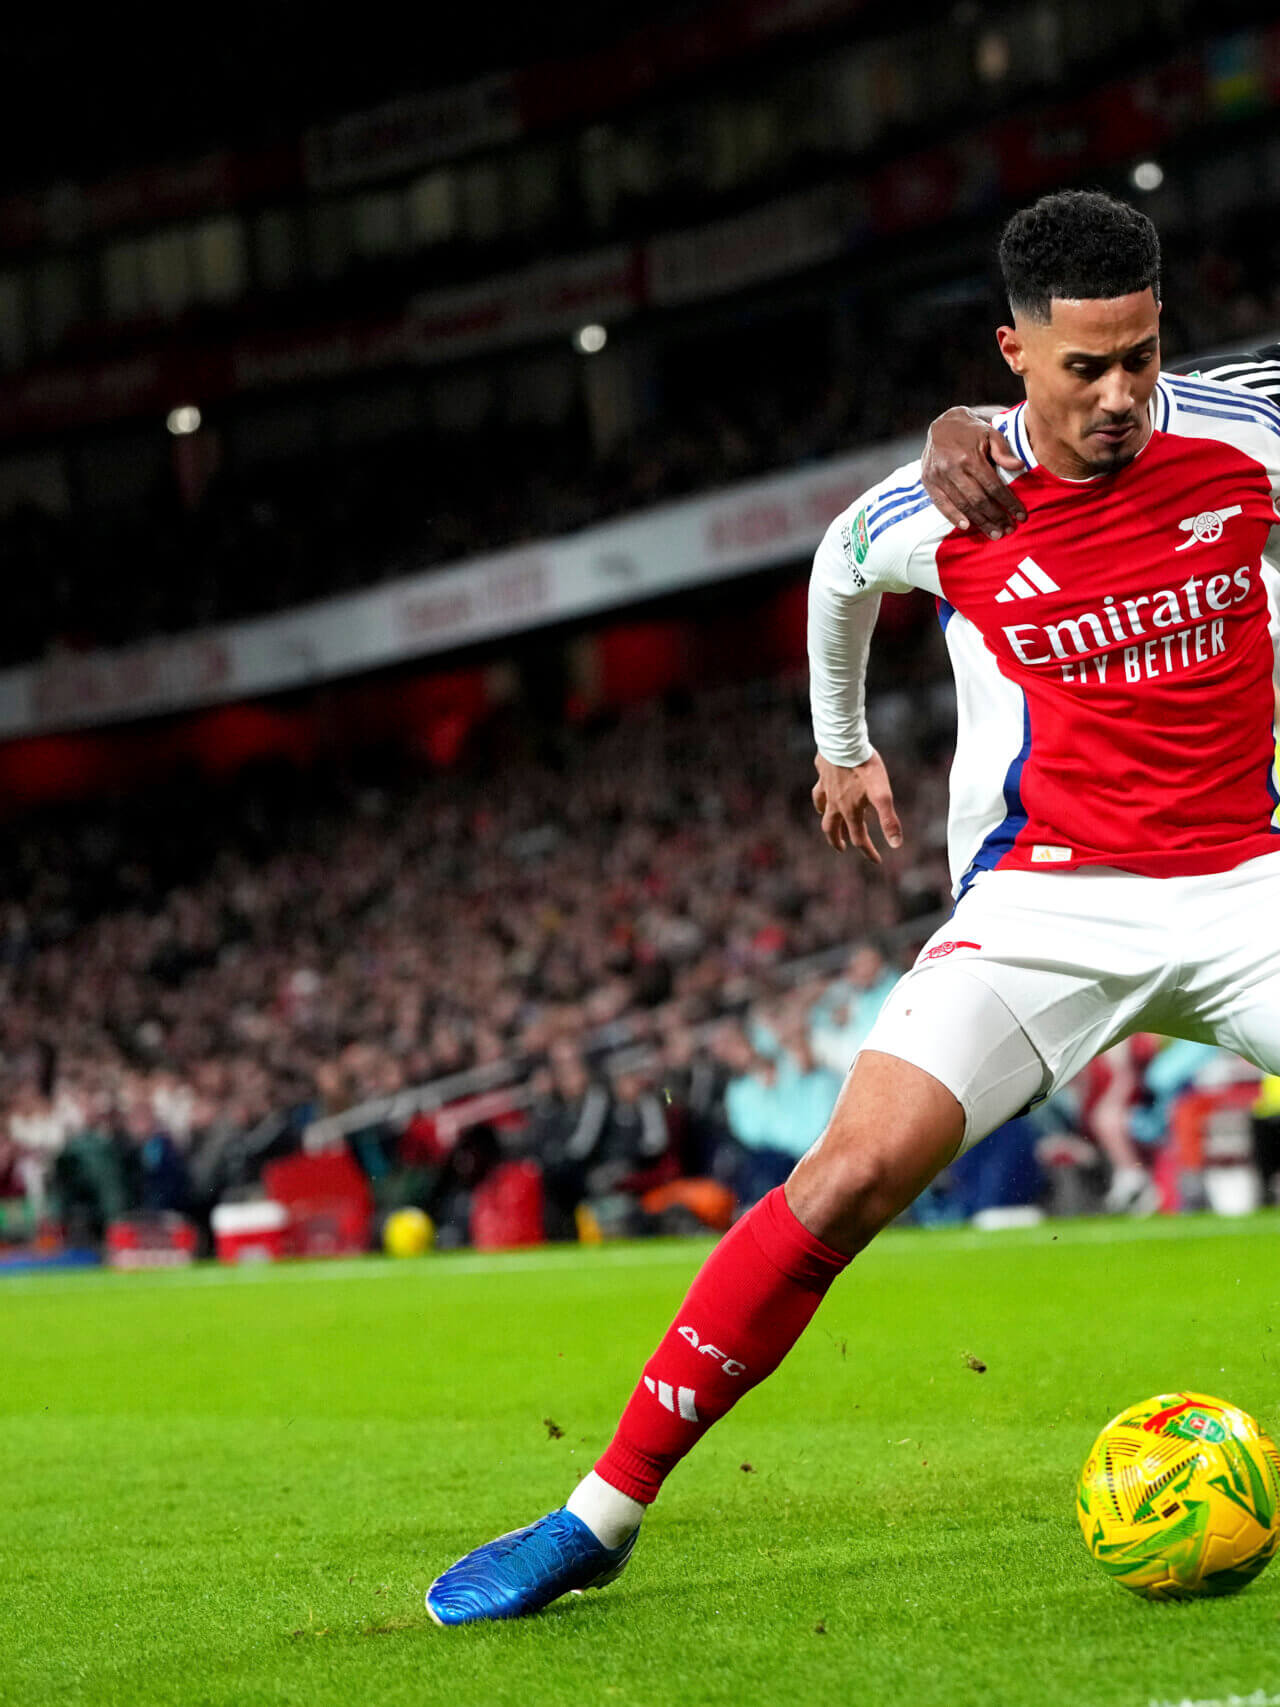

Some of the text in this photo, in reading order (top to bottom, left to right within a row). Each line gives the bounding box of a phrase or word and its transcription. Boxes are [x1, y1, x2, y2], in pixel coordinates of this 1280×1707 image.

[1001, 566, 1250, 665] Emirates
[1123, 617, 1226, 684] BETTER
[677, 1326, 746, 1376] AFC
